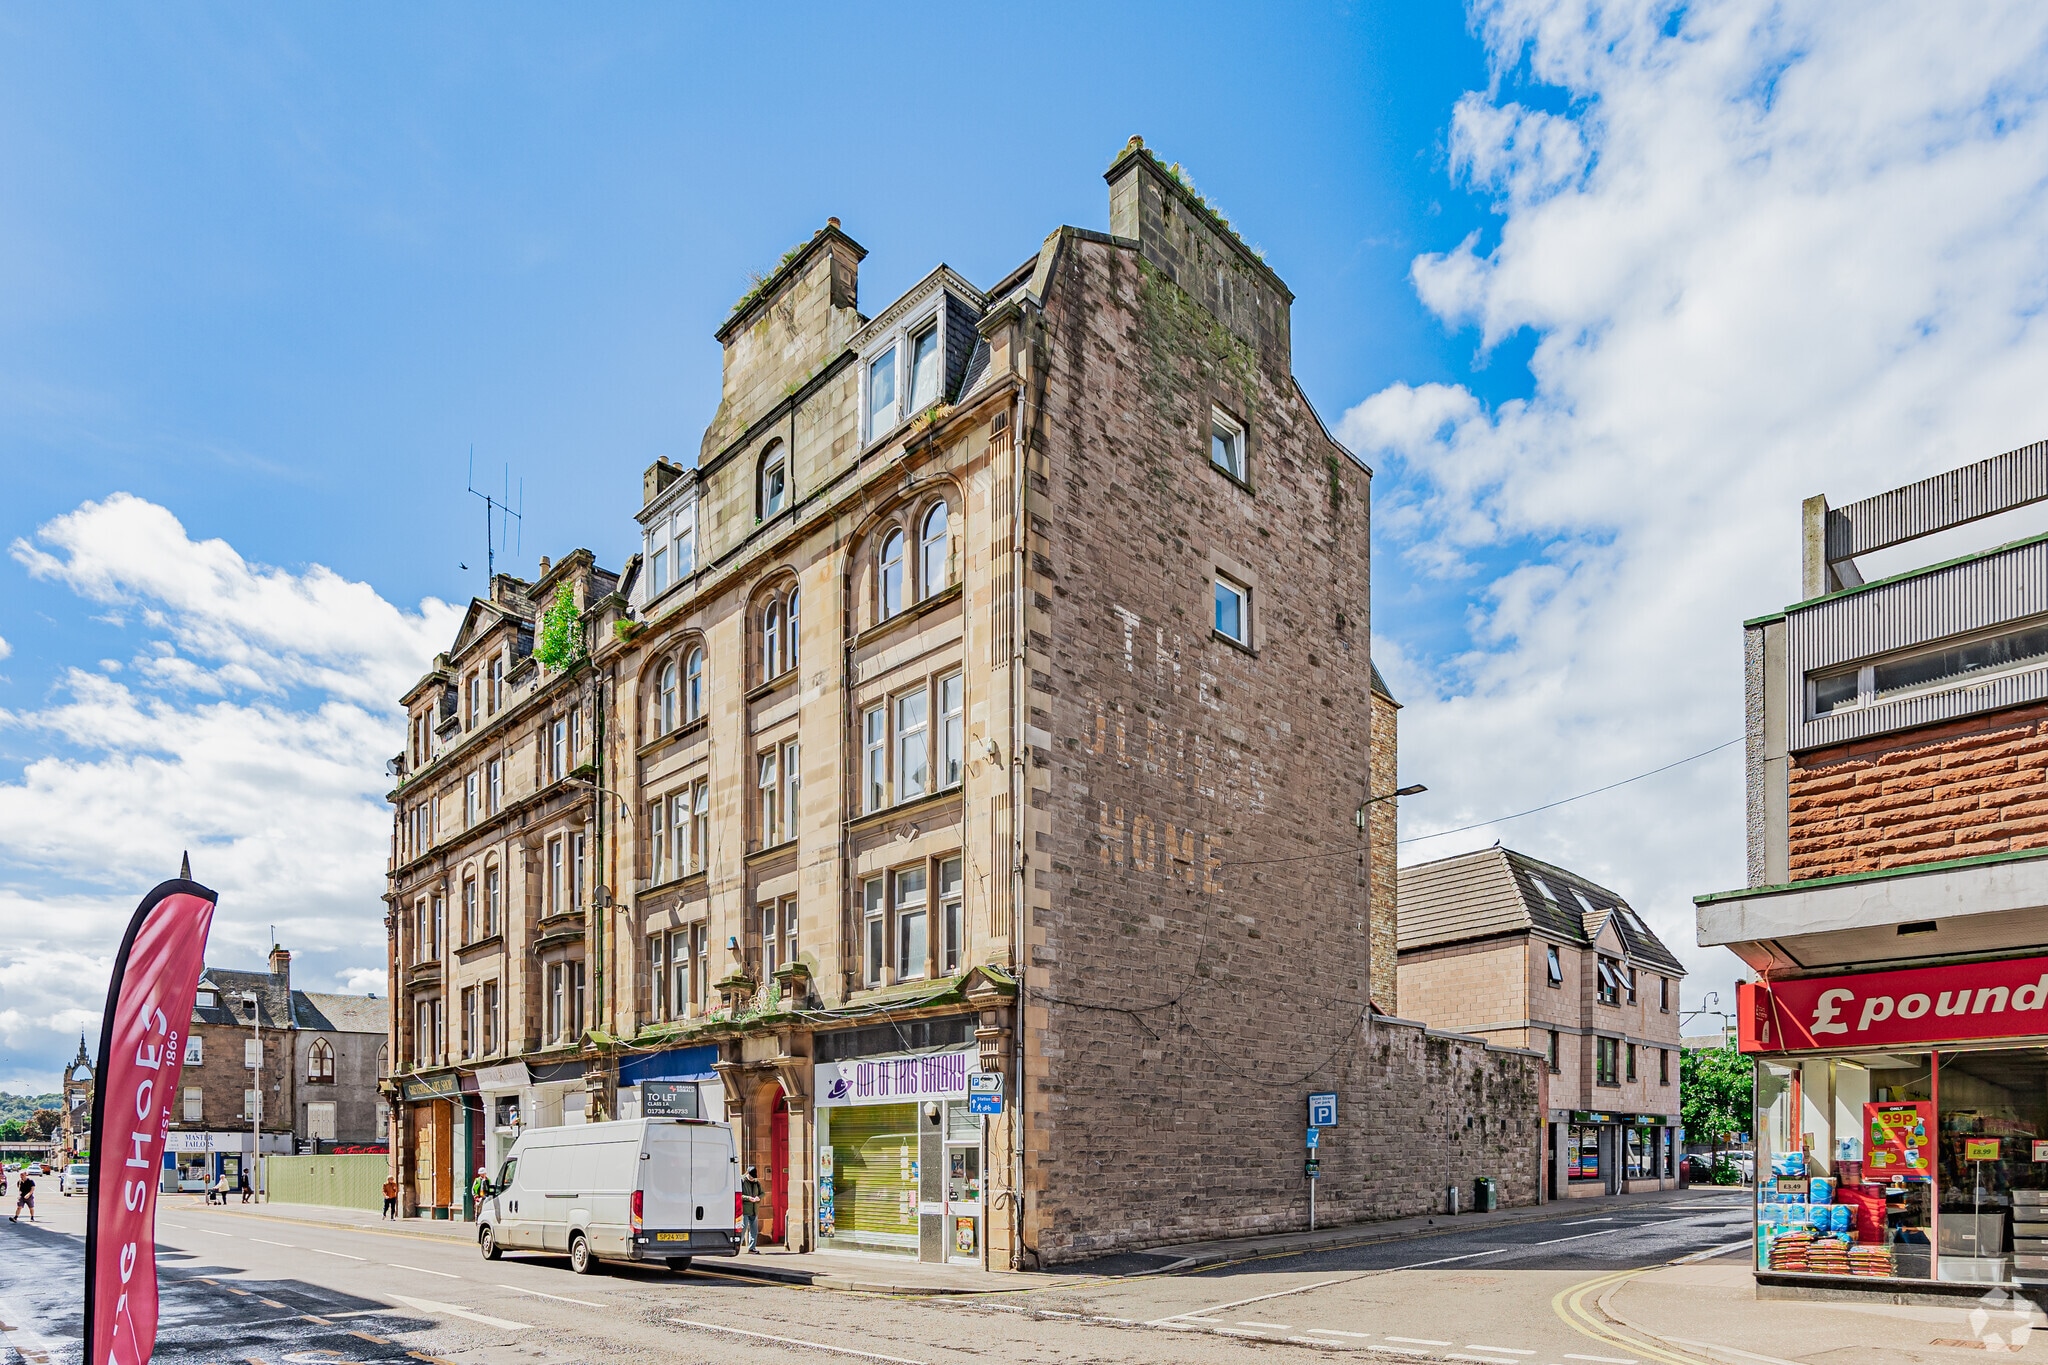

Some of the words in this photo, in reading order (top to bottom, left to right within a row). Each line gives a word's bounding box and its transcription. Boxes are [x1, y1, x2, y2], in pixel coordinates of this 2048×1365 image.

[1113, 603, 1221, 712] THE
[1099, 800, 1225, 895] HOME
[857, 1062, 875, 1097] OUT
[878, 1061, 891, 1096] OF
[893, 1058, 918, 1095] THIS
[921, 1054, 965, 1093] GALAXY
[125, 1002, 168, 1213] SHOES
[647, 1093, 660, 1101] TO
[662, 1093, 677, 1101] LET
[1318, 1107, 1329, 1122] P
[160, 1106, 170, 1140] EST
[1882, 1113, 1914, 1125] 99p
